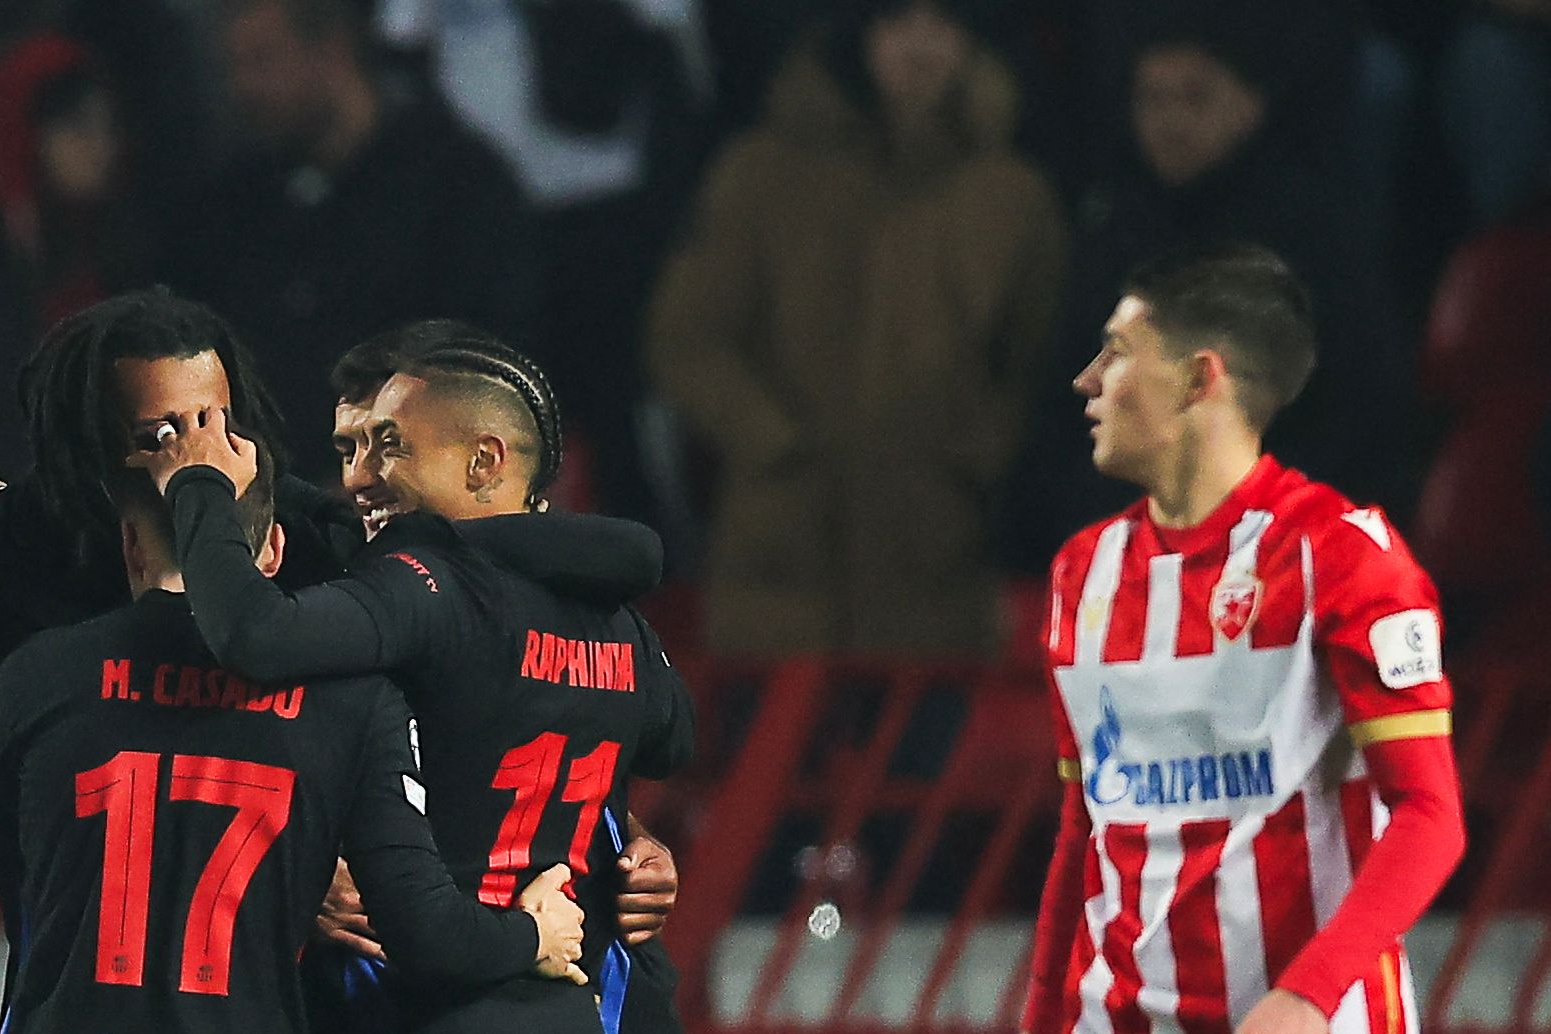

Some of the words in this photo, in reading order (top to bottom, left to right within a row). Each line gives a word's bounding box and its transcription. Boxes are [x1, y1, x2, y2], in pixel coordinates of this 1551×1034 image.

[101, 658, 141, 701] M.
[75, 750, 297, 997] 17
[478, 731, 623, 907] 11
